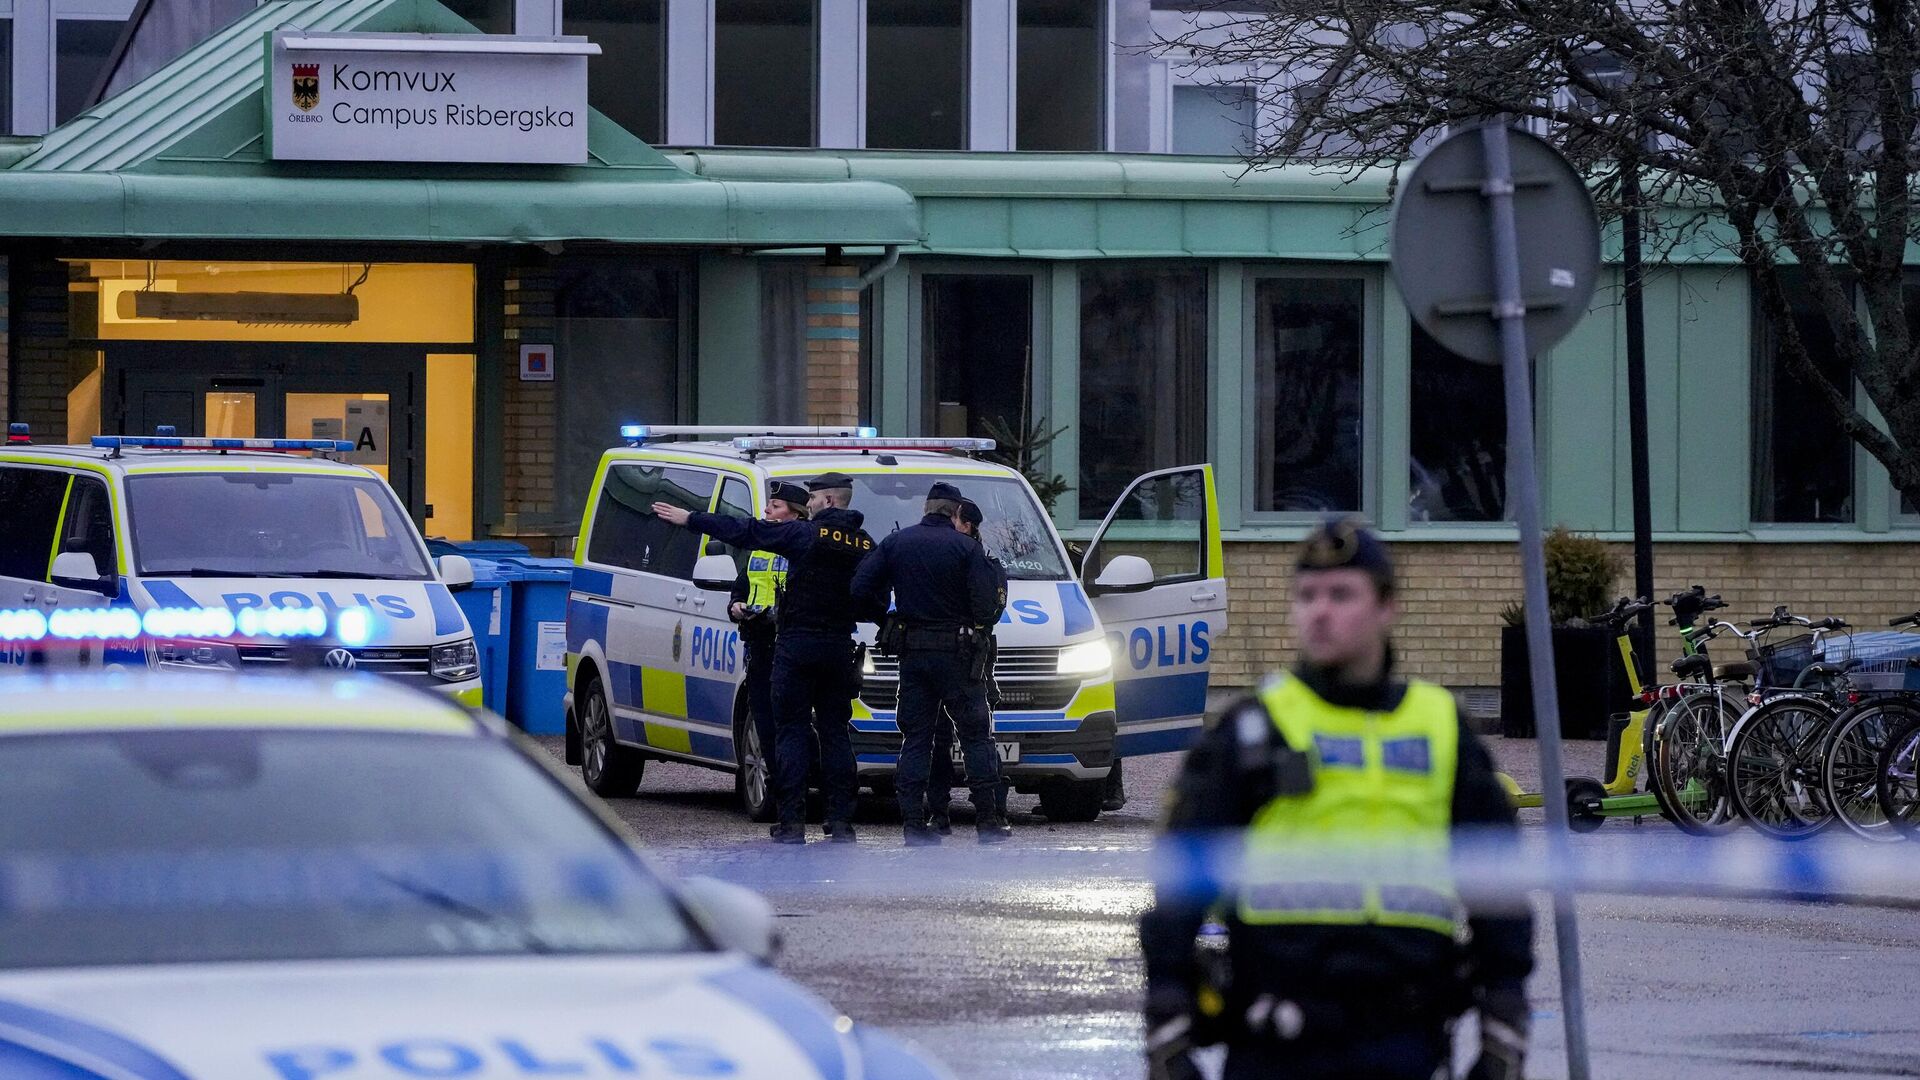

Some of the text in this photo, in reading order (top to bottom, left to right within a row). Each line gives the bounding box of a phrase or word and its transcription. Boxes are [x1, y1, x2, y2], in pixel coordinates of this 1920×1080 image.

[332, 64, 456, 92] Komvux
[288, 113, 323, 122] ÖREBRO
[332, 102, 574, 132] Campus Risbergska
[356, 427, 376, 451] A
[820, 528, 871, 550] POLIS
[691, 626, 738, 674] POLIS
[262, 1038, 738, 1080] POLIS
